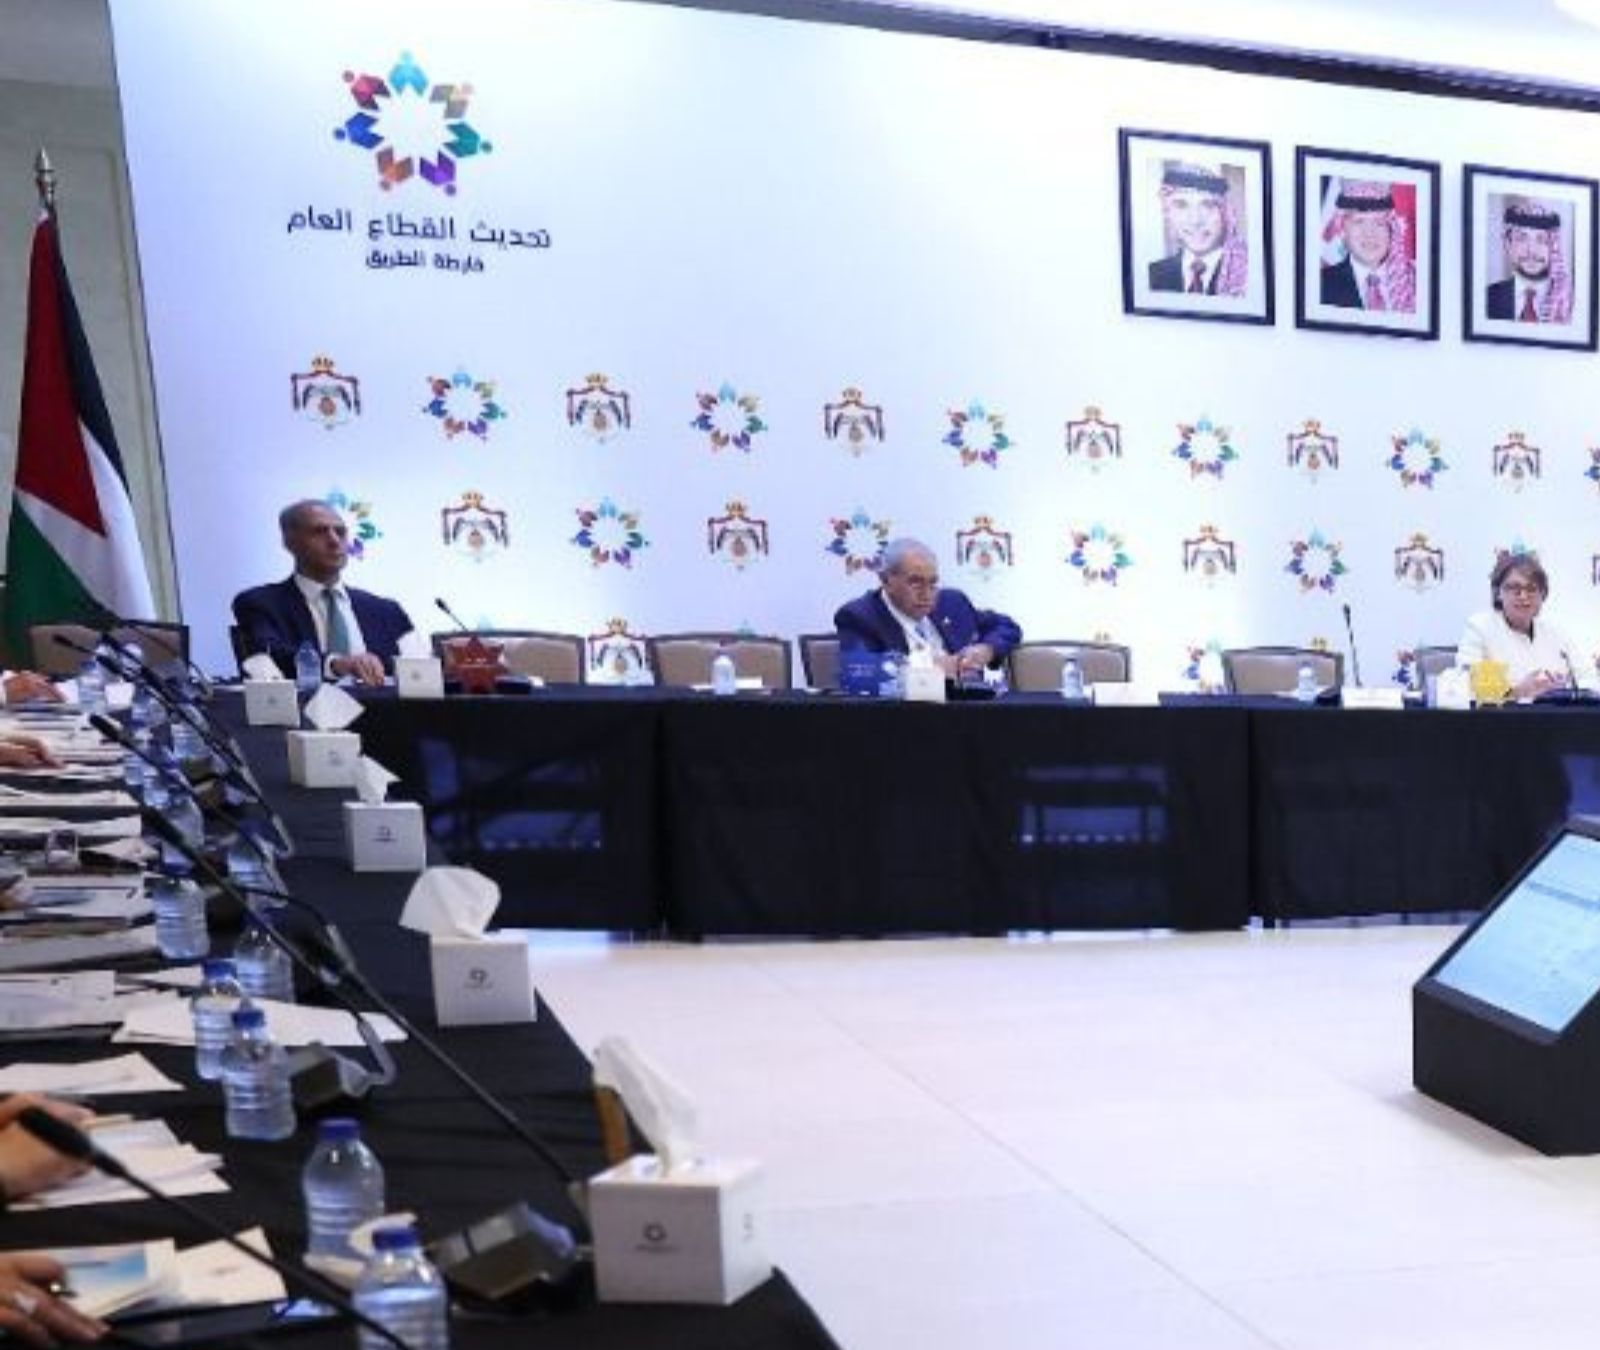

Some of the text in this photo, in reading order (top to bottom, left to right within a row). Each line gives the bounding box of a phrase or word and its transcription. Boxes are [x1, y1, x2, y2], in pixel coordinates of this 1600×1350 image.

[287, 204, 551, 250] تحديث القطاع العام
[366, 249, 484, 275] خارطة الطريق
